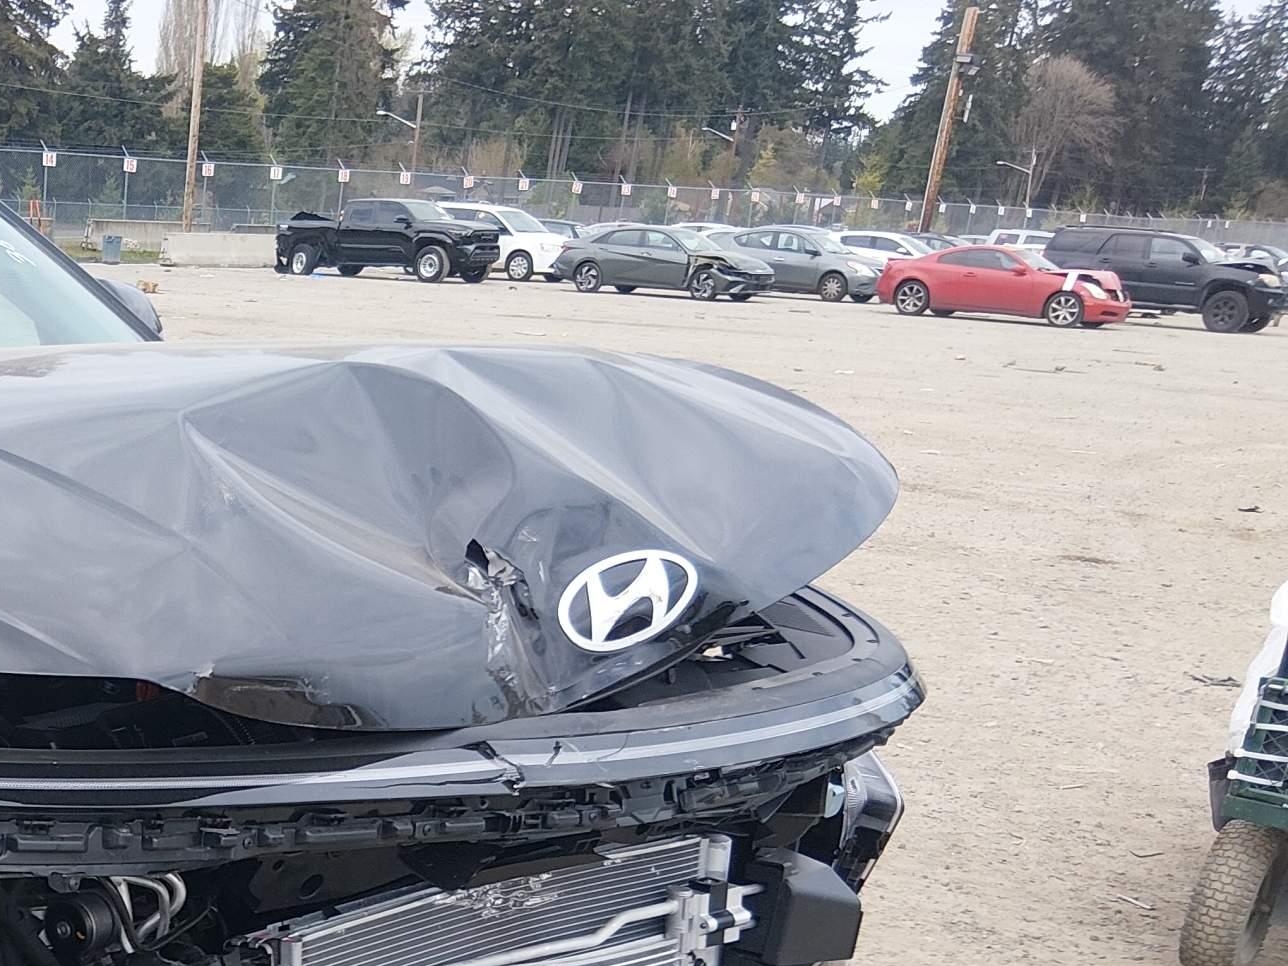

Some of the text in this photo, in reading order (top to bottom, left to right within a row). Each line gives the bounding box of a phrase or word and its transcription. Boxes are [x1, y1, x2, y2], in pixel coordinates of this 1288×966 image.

[45, 153, 54, 165] 14
[125, 159, 136, 171] 15
[203, 164, 213, 176] 16
[272, 167, 281, 179] 17
